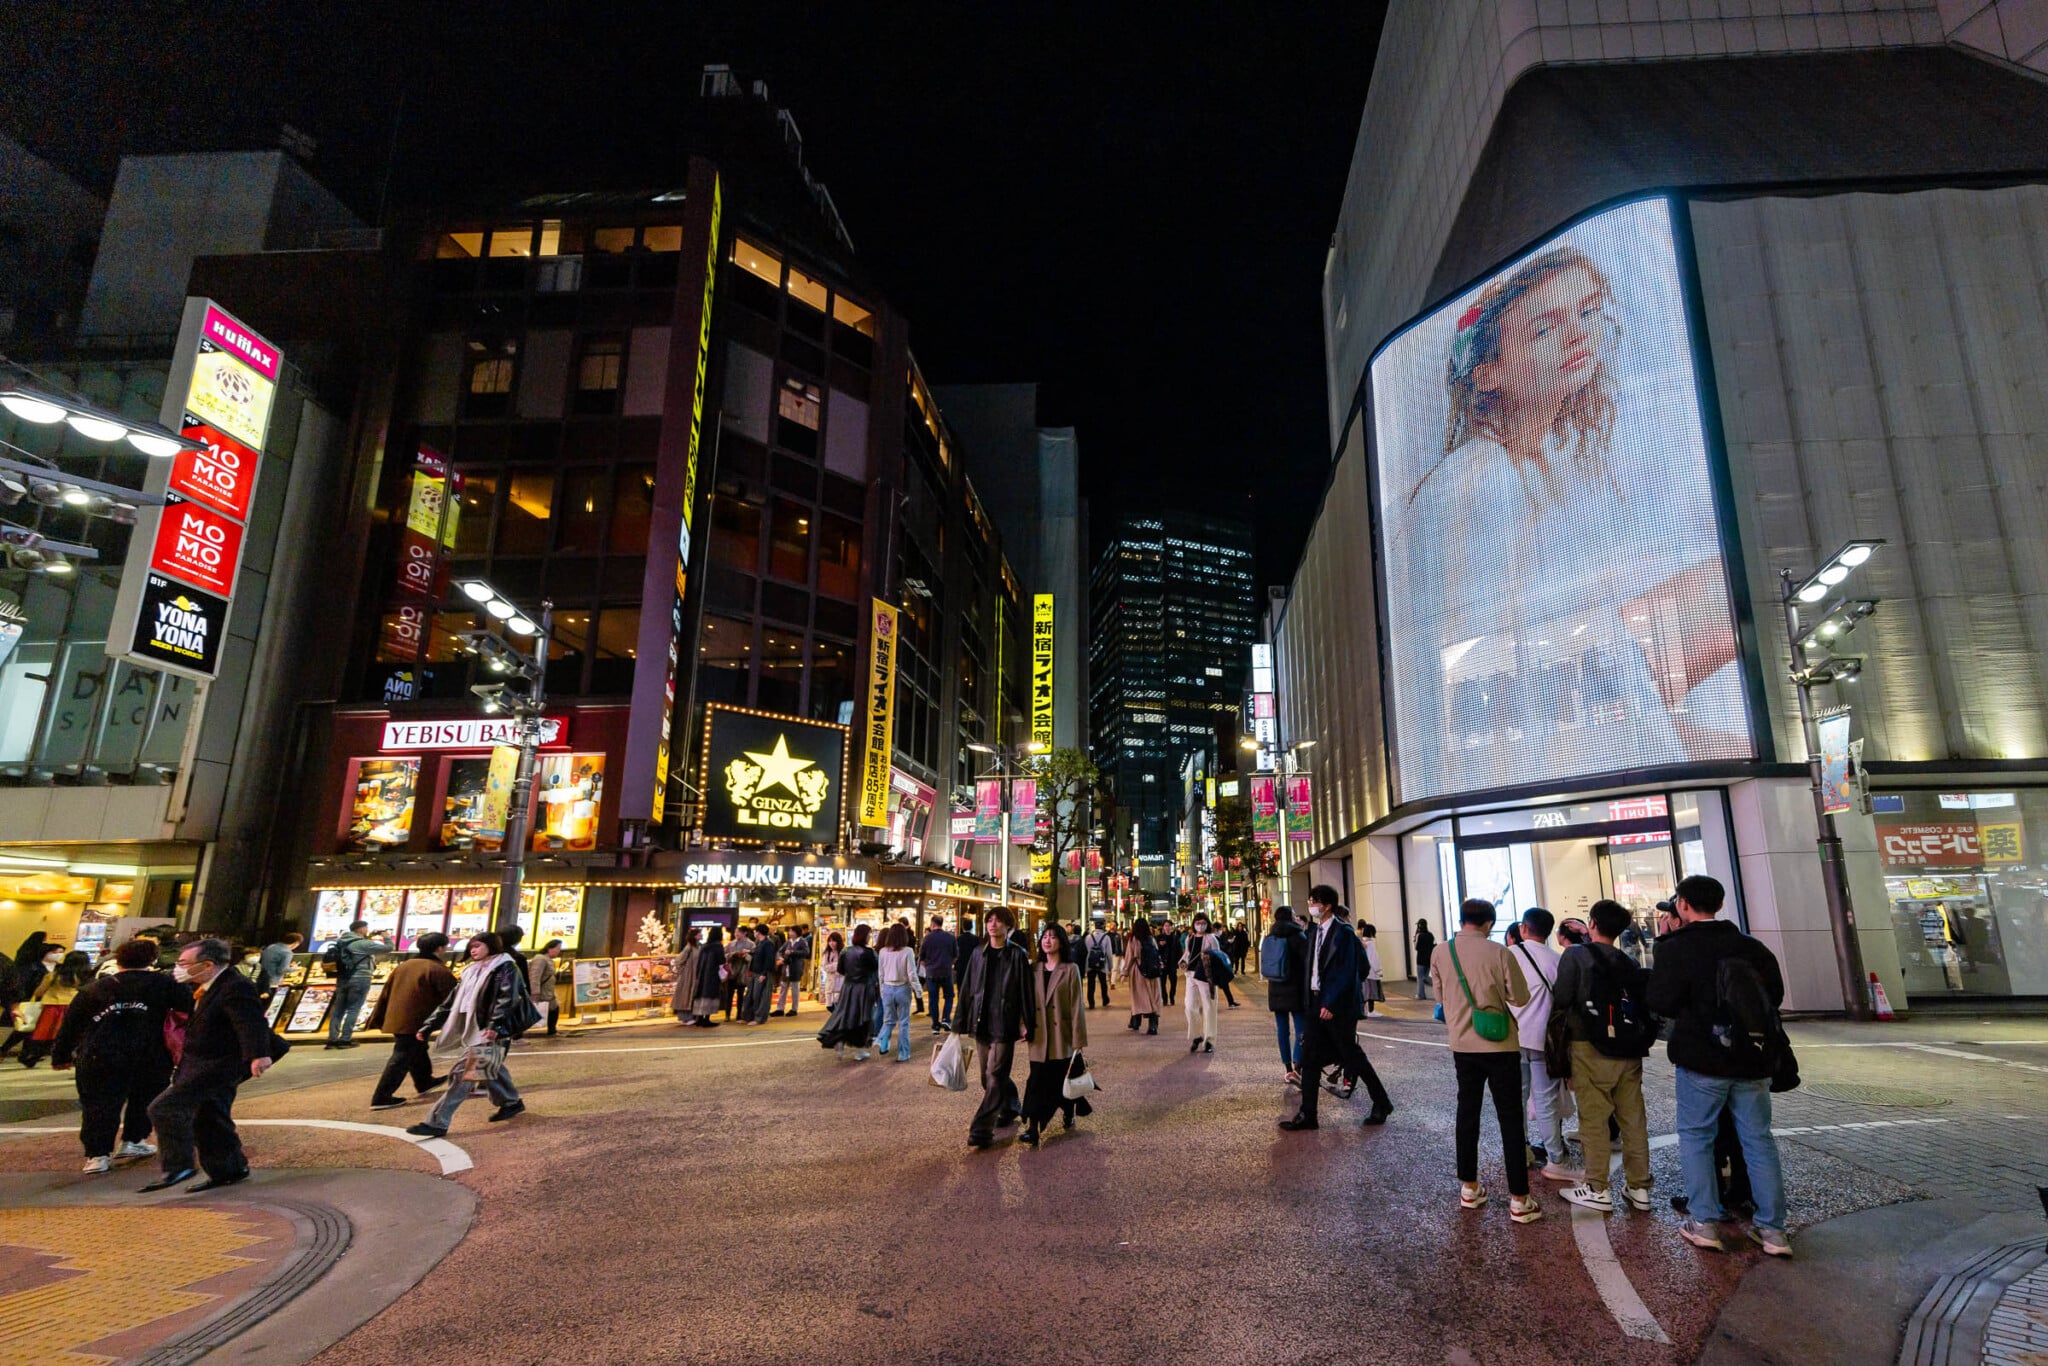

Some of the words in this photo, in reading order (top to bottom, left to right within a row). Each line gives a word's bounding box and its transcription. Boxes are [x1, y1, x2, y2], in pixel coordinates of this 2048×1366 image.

[185, 416, 199, 426] 4F
[193, 457, 235, 490] MO
[167, 494, 182, 503] 4F
[192, 475, 233, 498] PARADISE
[182, 512, 225, 543] MO
[176, 535, 220, 565] MO
[174, 552, 218, 574] PARADISE
[150, 576, 167, 588] B1F
[158, 602, 208, 636] YONA
[154, 620, 204, 654] YONA
[870, 637, 891, 751] 新宿ライオン会館
[1034, 620, 1053, 749] 新宿ライオン会館
[391, 724, 471, 745] YEBISU
[865, 751, 881, 819] 開店85周年
[876, 754, 888, 811] おかげさまで
[751, 796, 804, 813] GINZA
[737, 808, 813, 829] LION
[1533, 811, 1568, 829] ZARA
[684, 863, 784, 885] SHINJUKU
[792, 865, 834, 886] BEER
[838, 868, 868, 888] HALL
